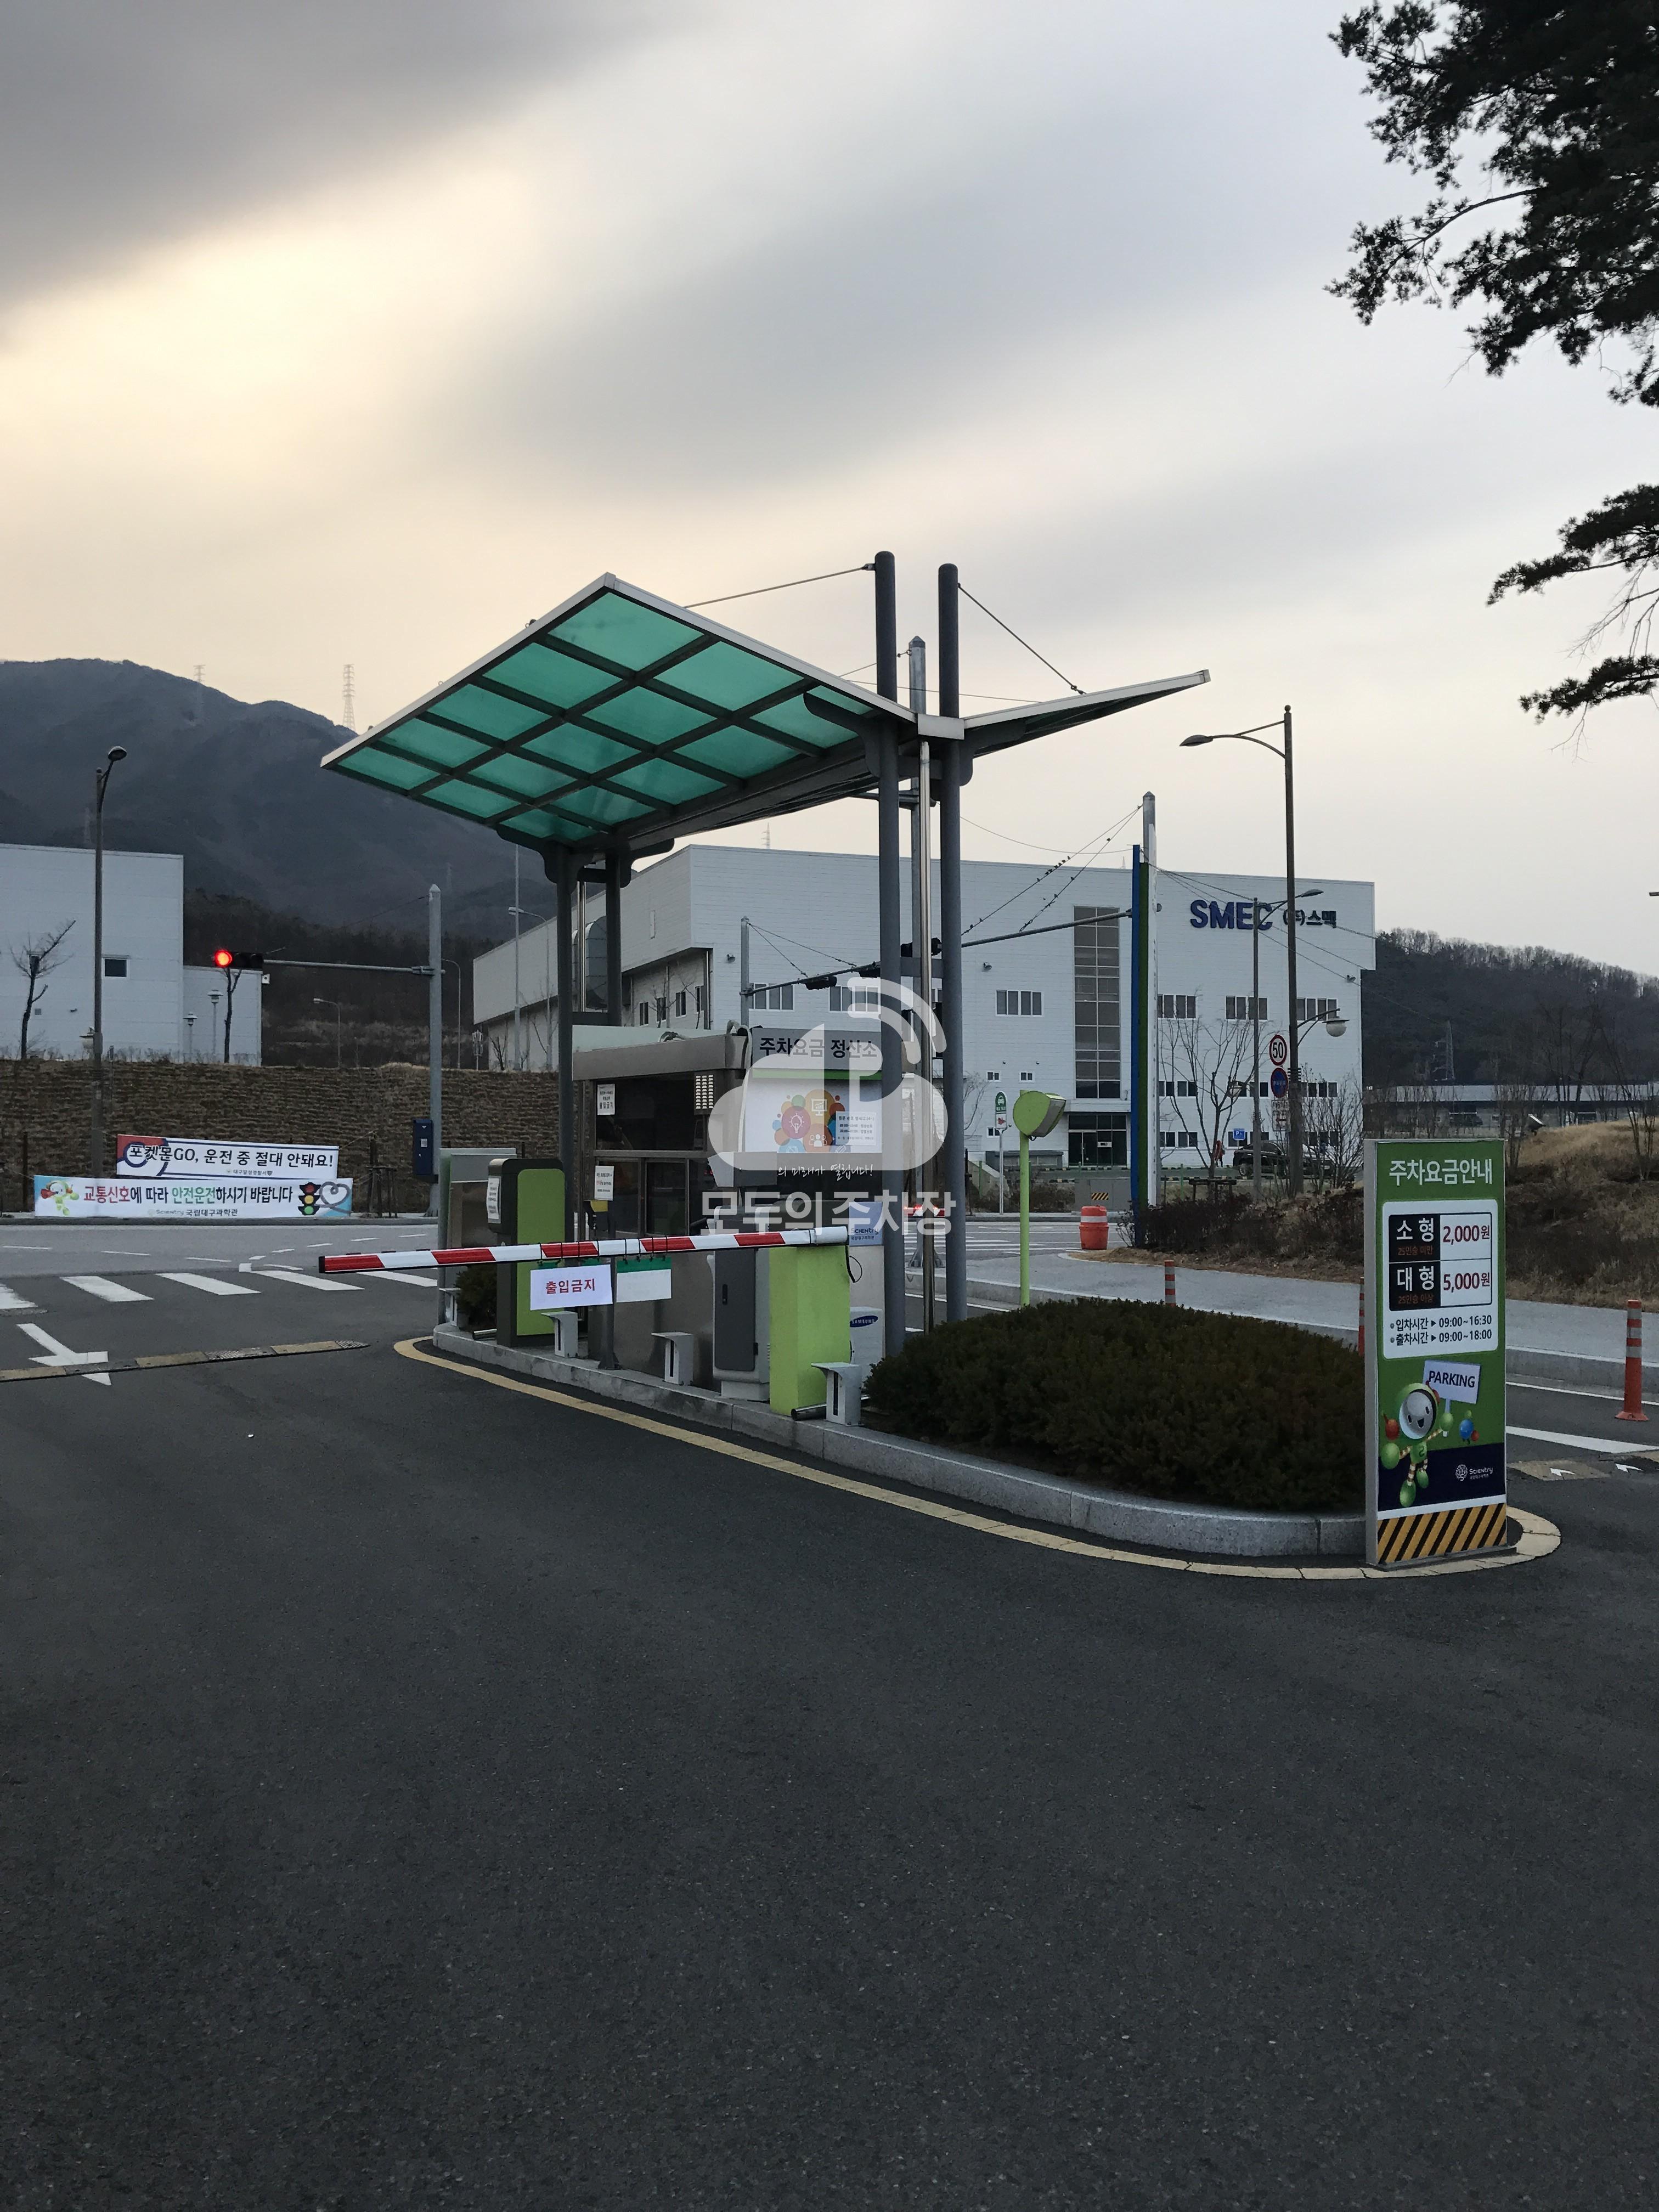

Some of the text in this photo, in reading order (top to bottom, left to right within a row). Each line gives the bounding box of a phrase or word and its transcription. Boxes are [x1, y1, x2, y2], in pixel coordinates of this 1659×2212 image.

[1190, 899, 1273, 930] SMEC
[759, 1037, 878, 1058] 주차요금 정산소
[1272, 1042, 1284, 1059] 50
[129, 1145, 333, 1167] 포켓몬GO, 운전 중 절대 안돼요!
[792, 1165, 826, 1177] 미래가
[830, 1164, 873, 1181] 열립니다!
[1389, 1158, 1492, 1186] 주차요금안내
[84, 1186, 293, 1204] 교통신호에 따라 안전운전하시기 바랍니다
[1443, 1224, 1490, 1245] 2,000원
[545, 1278, 596, 1294] 출입금지
[1443, 1272, 1490, 1293] 5,000원
[1396, 1315, 1492, 1331] 입차시간 09:00~16:30
[1396, 1329, 1492, 1346] 출차시간 09:00~18:00
[1429, 1370, 1475, 1388] PARKING
